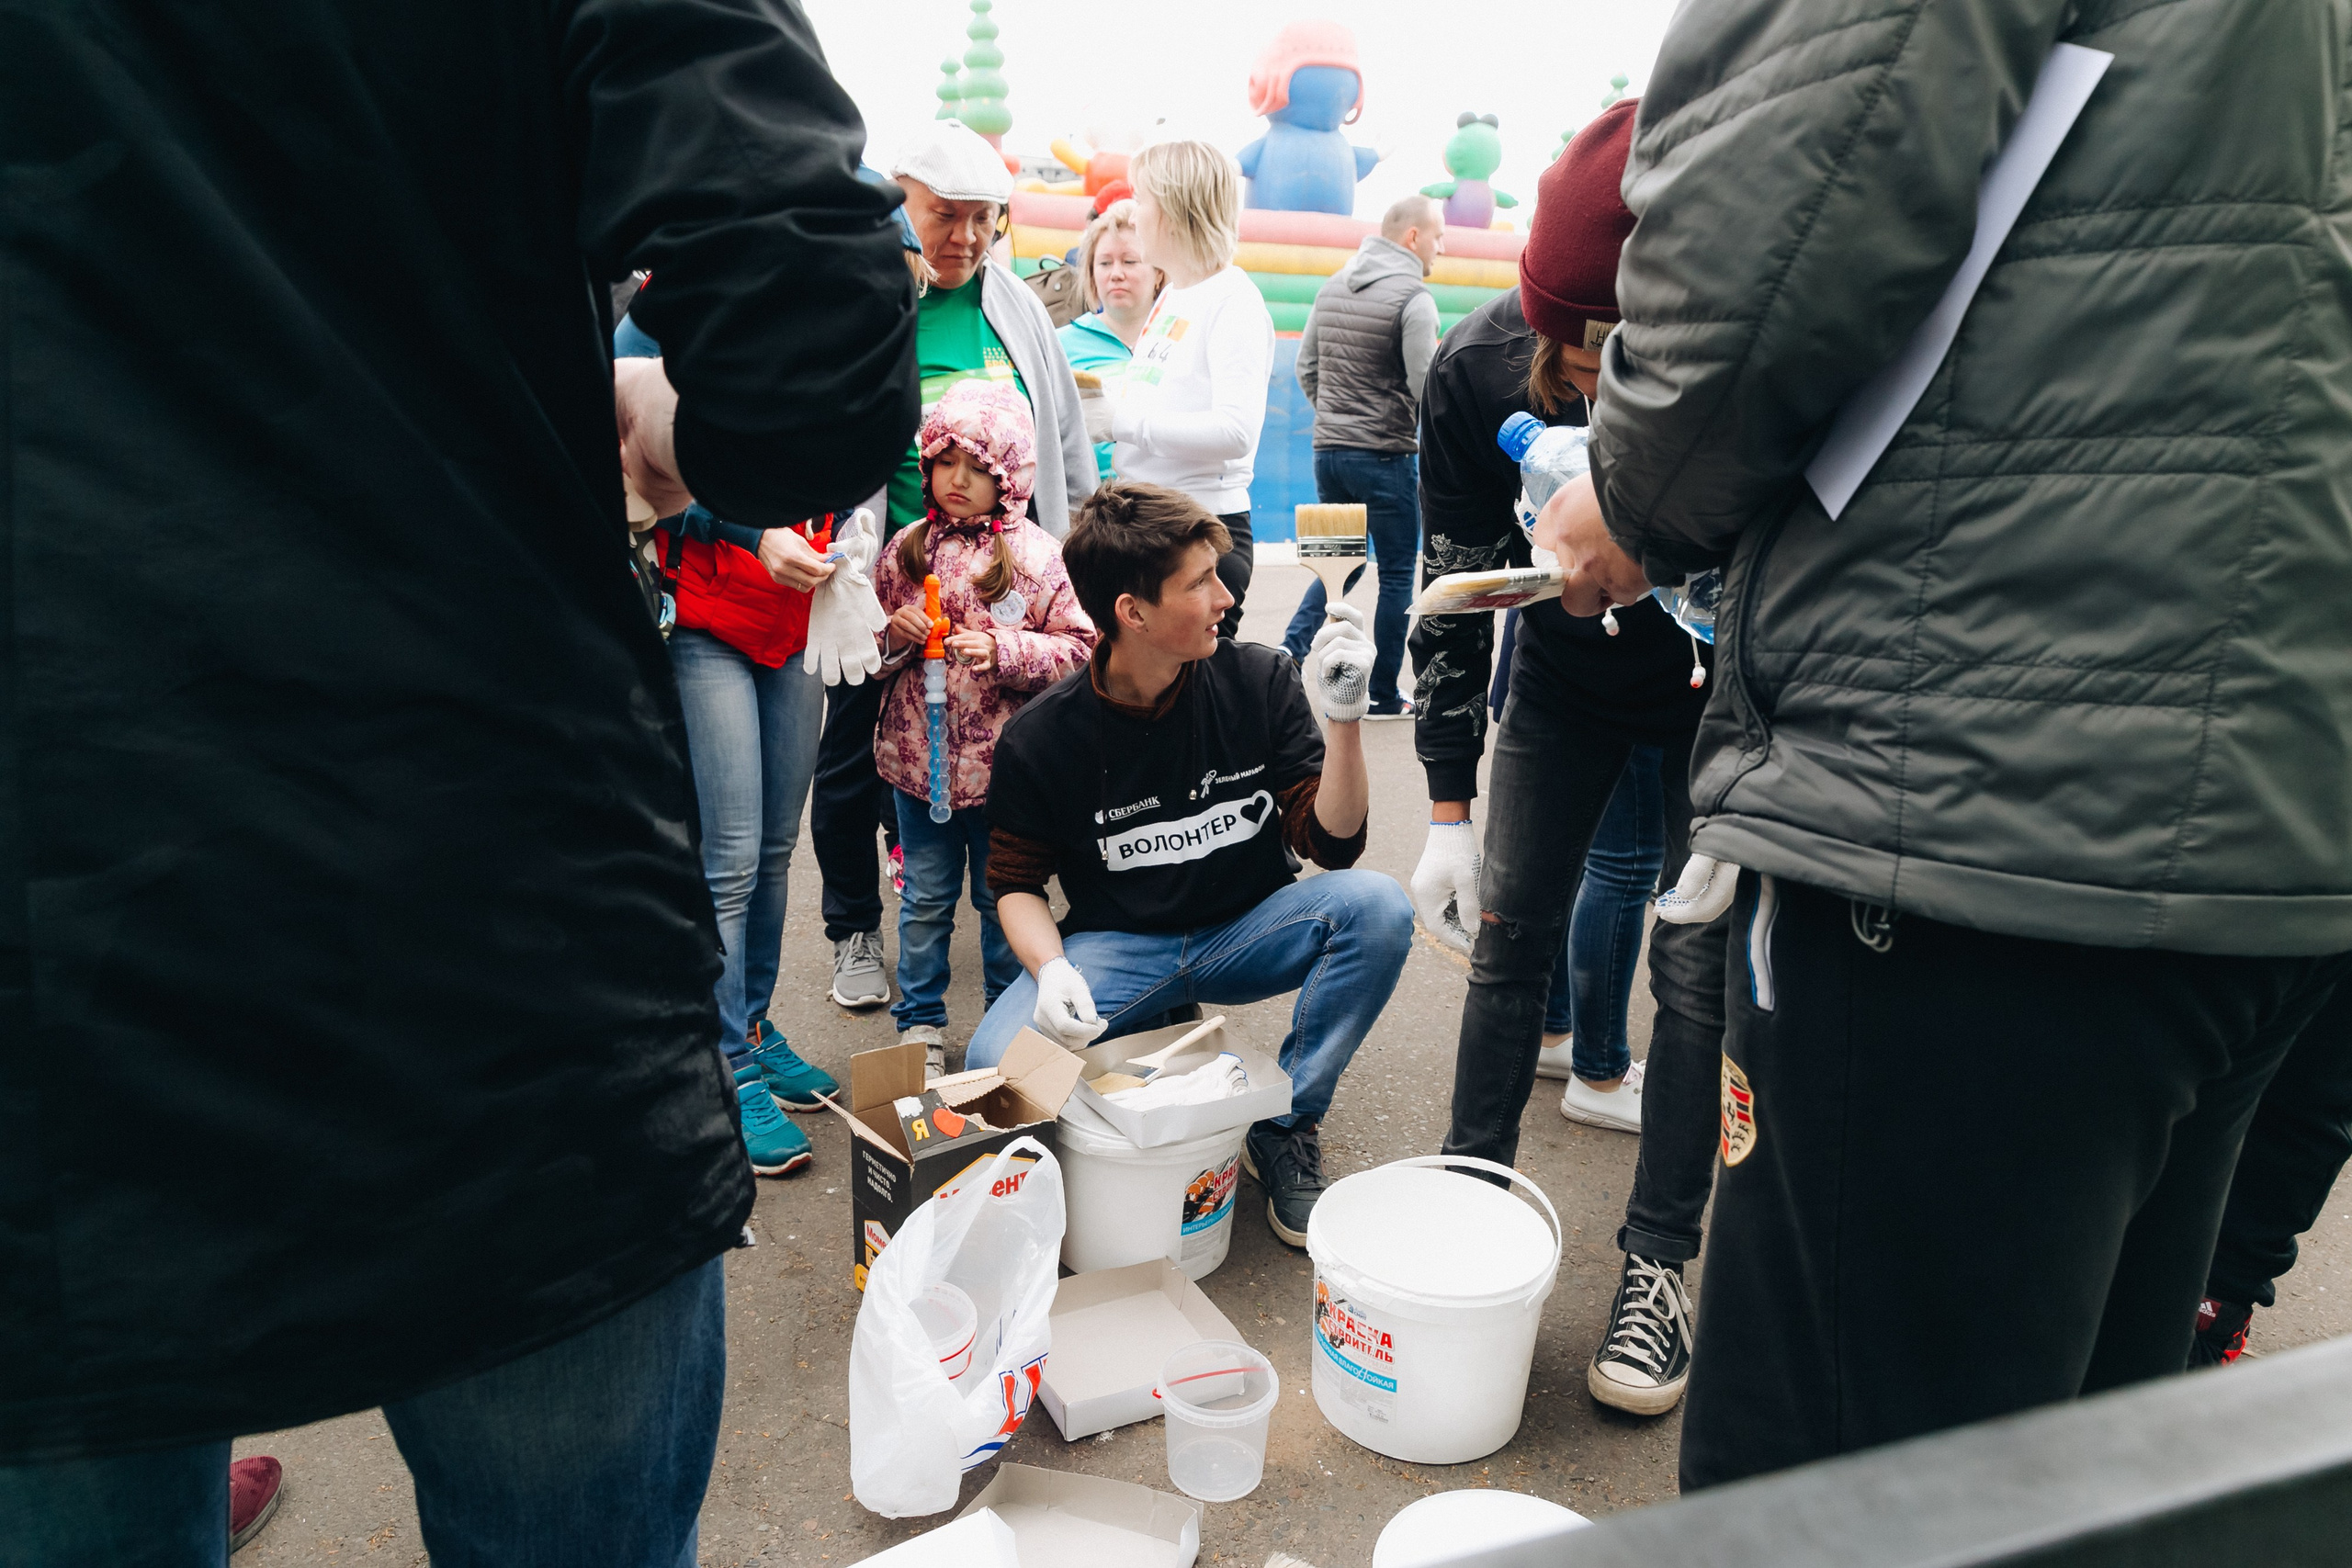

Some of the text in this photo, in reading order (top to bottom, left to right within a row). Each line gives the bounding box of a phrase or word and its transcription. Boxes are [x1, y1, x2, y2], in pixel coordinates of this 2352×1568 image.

[1215, 763, 1266, 784] ЗЕЛЕНЫЙ МАРАФОН
[1108, 795, 1160, 819] СБЕРБАНК
[1118, 814, 1238, 860] ВОЛОНТЕР
[911, 1118, 931, 1141] Я
[862, 1150, 897, 1183] ГЕРМЕТИЧНО
[866, 1176, 894, 1203] НАДОЛГО.
[865, 1224, 888, 1249] Моме
